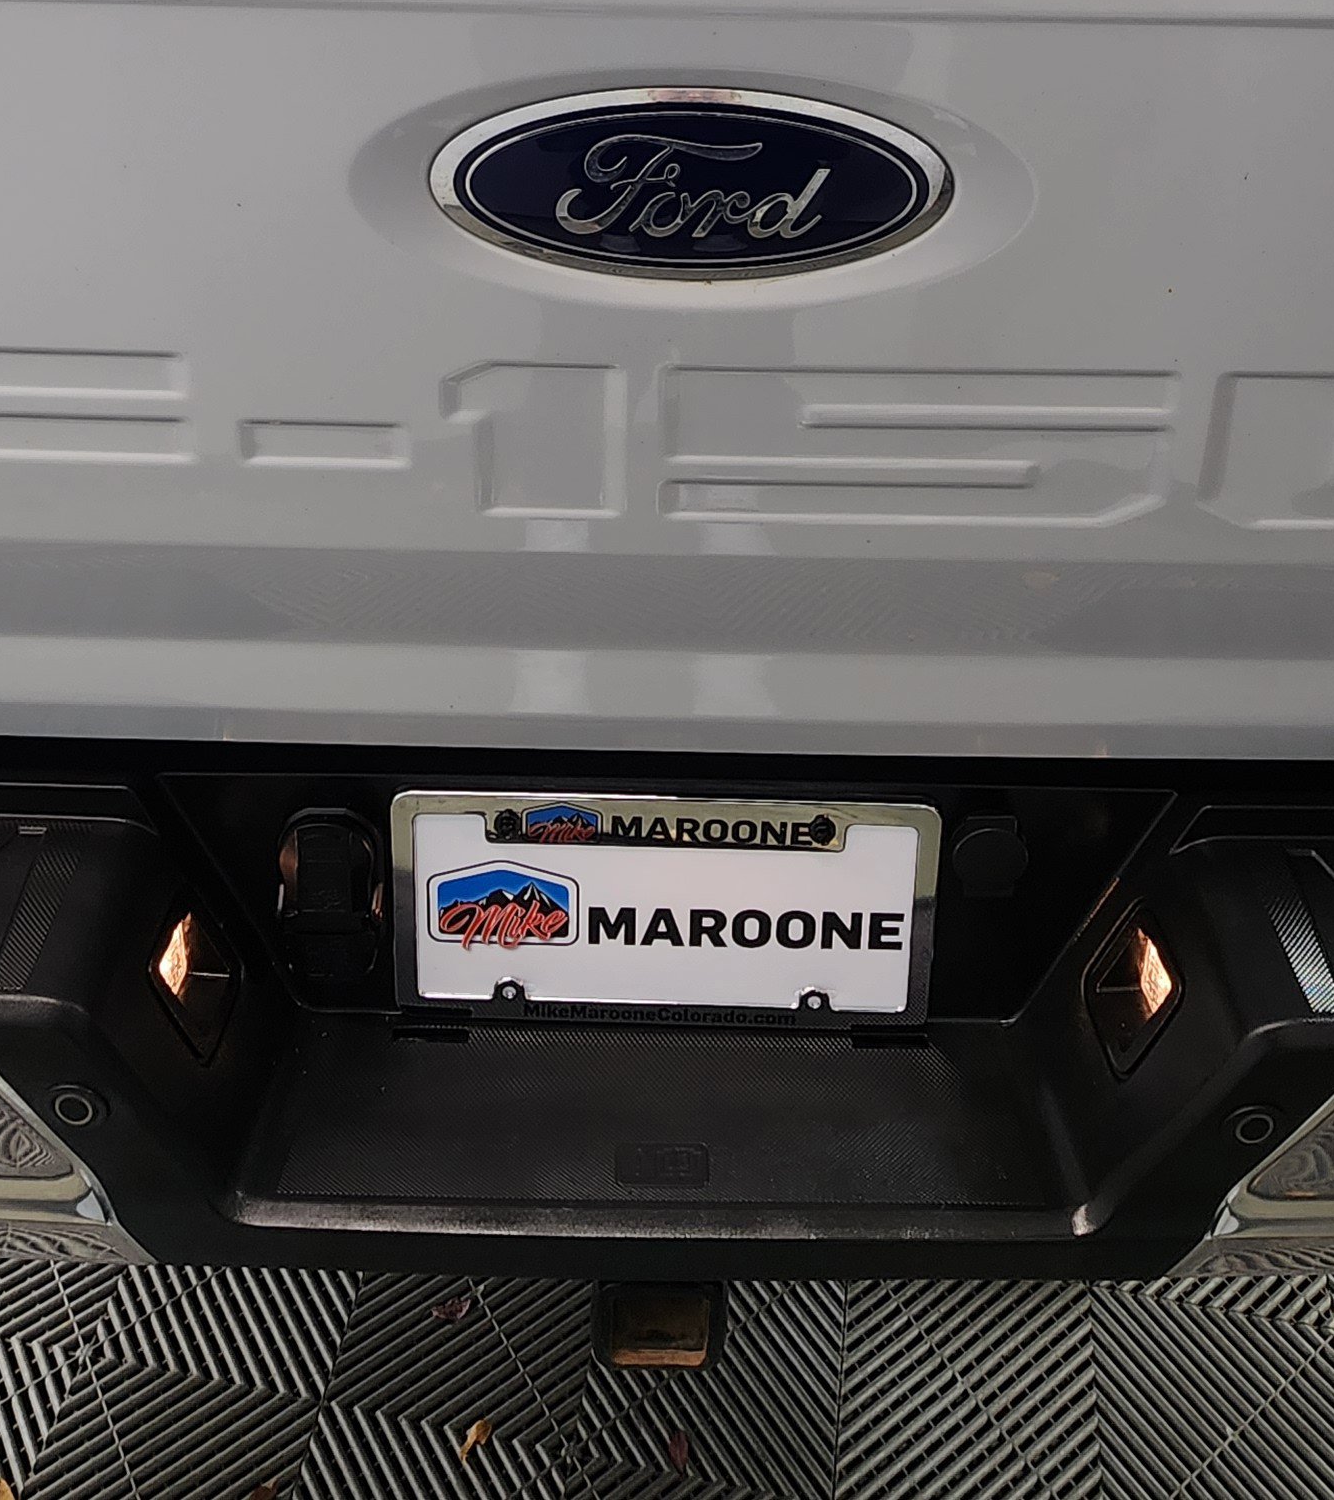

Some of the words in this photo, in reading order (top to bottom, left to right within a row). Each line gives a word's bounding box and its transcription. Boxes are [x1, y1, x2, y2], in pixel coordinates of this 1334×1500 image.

[555, 133, 832, 239] Ford
[528, 818, 596, 844] Mike
[610, 815, 813, 846] MAROONE
[439, 899, 568, 950] Mike
[587, 906, 905, 951] MAROONE
[523, 1002, 797, 1027] MikeMarooneColorado.com
